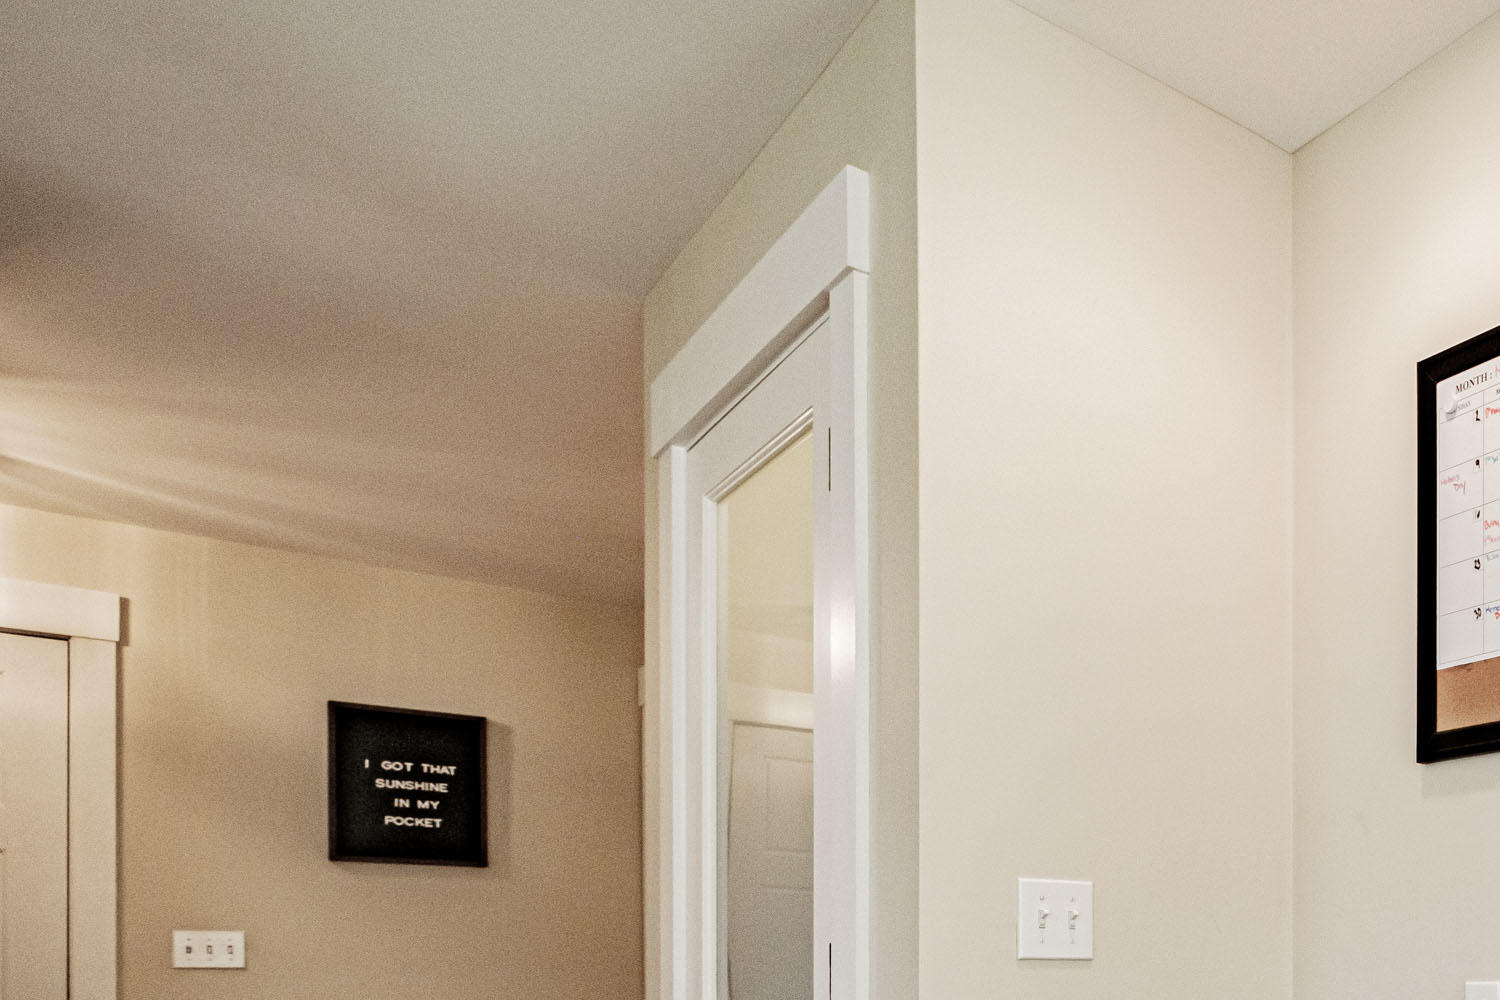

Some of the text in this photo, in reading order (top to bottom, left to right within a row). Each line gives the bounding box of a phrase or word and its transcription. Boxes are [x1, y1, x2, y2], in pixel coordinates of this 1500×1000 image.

[364, 758, 457, 776] I GOT THAT
[374, 778, 449, 793] SUNSHINE
[394, 798, 440, 810] IN MY
[384, 815, 442, 828] POCKET
